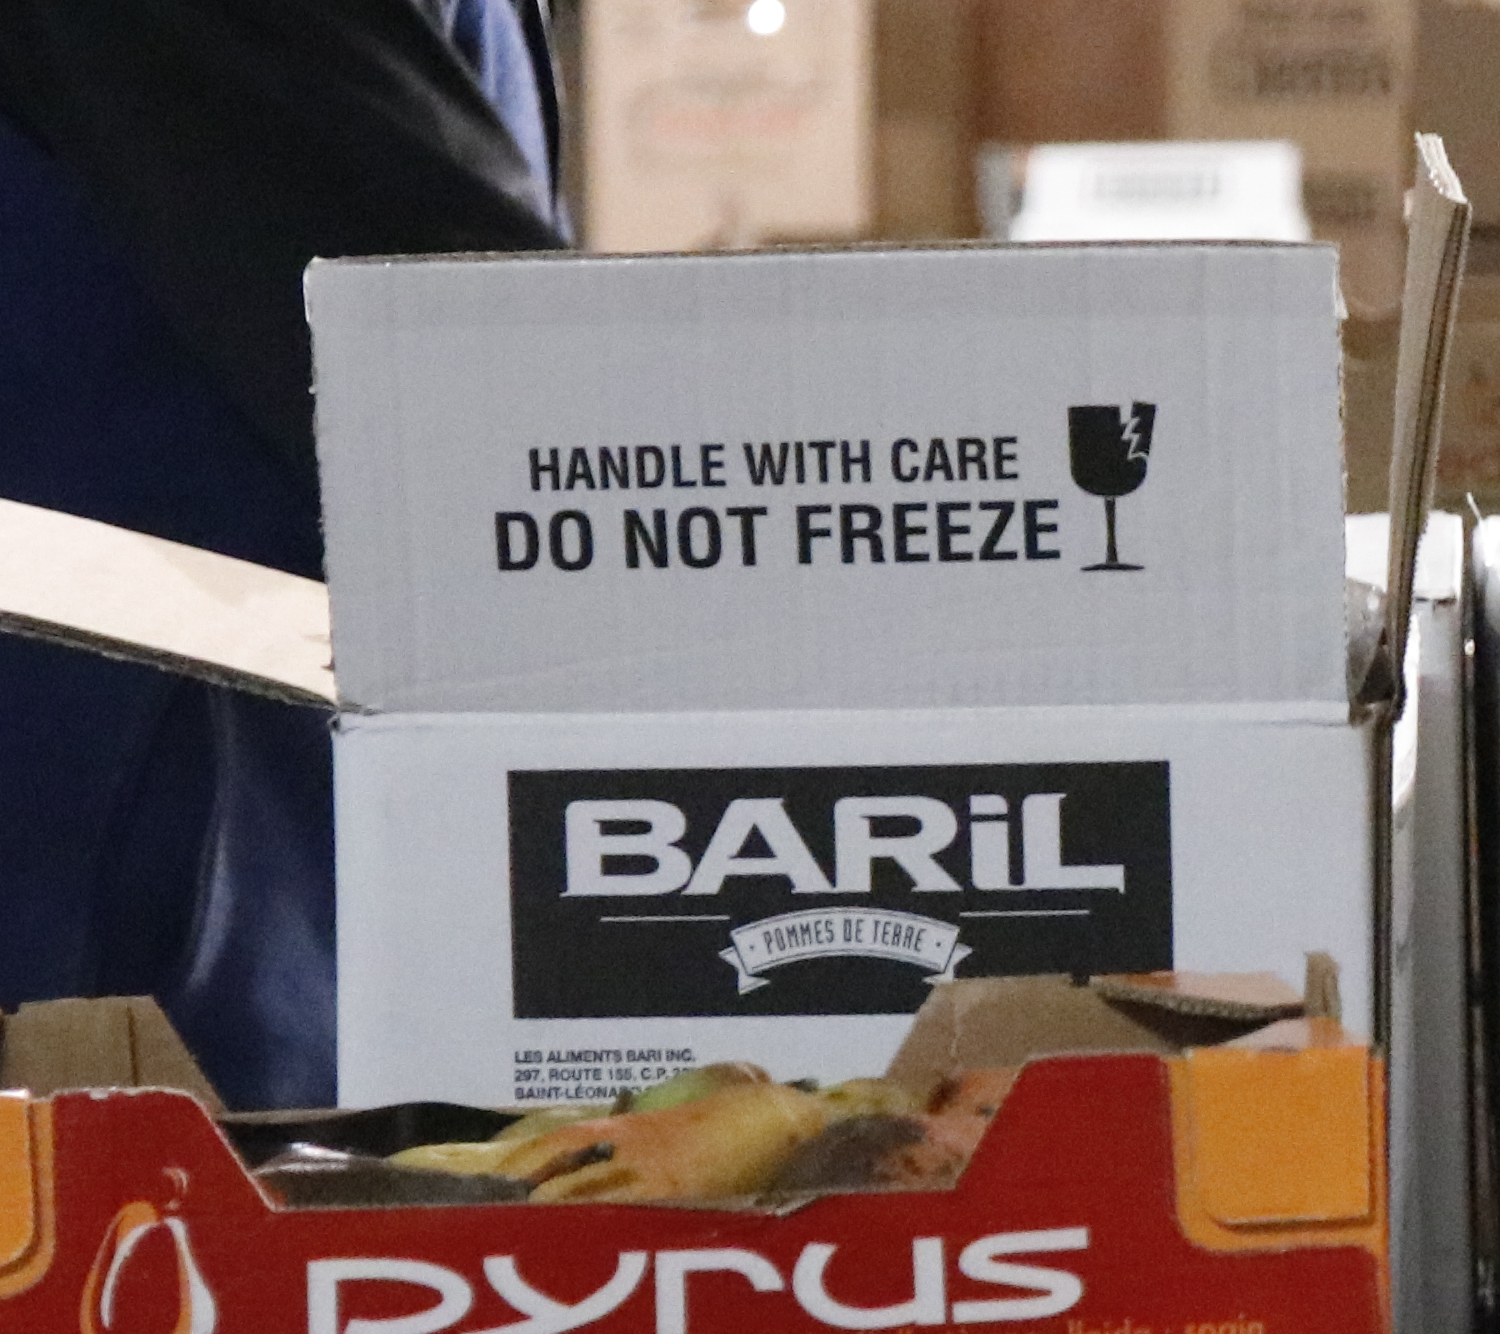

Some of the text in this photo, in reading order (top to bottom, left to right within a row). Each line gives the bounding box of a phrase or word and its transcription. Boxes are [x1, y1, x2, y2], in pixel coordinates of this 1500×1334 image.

[528, 436, 1018, 491] HANDLE WITH CARE
[495, 499, 1061, 571] DO NOT FREEZE
[763, 918, 927, 954] POMMES DE TERRE
[514, 1050, 542, 1063] LES
[546, 1049, 622, 1063] ALIMENTS
[548, 1069, 602, 1081] ROUTE
